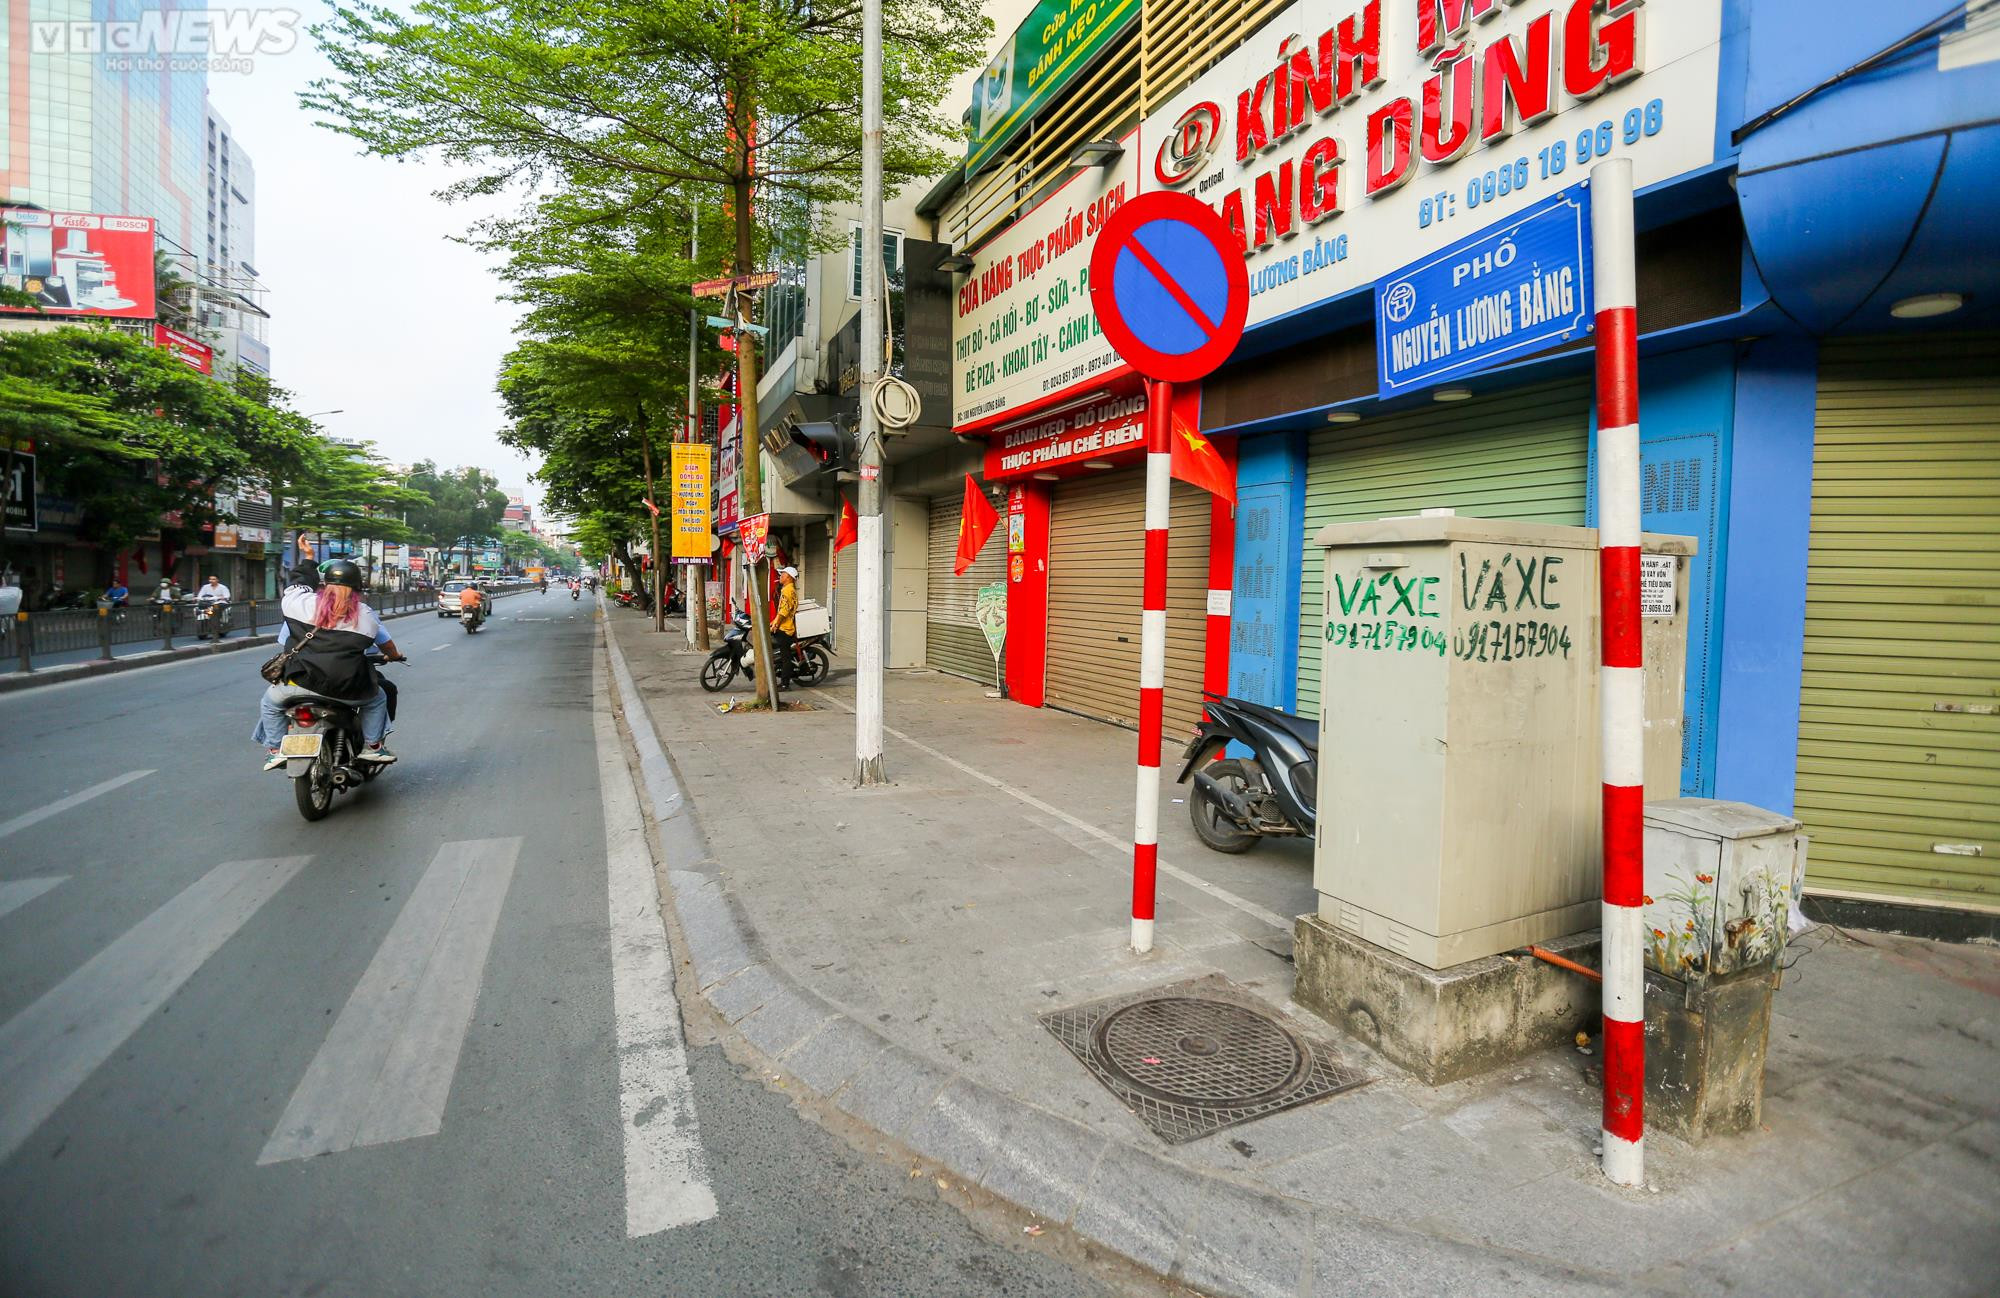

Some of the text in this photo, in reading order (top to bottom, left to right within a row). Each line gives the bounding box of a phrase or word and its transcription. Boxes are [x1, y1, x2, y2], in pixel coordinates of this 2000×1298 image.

[1028, 37, 1063, 88] BÁNH
[1066, 3, 1096, 47] KẸO
[1237, 0, 1384, 164] KÍNH
[1366, 0, 1646, 198] DŨNG
[1419, 98, 1663, 229] ĐT: 0986 18 96 98
[116, 220, 147, 229] BOSCH
[1017, 238, 1045, 283] THỰC
[1047, 206, 1083, 264] PHẨM
[1453, 227, 1520, 288] PHỐ
[1250, 234, 1348, 297] LƯƠNG BẰNG
[956, 335, 970, 363] THỊT
[972, 323, 983, 354] BÒ
[990, 314, 1001, 344] CÁ
[1002, 302, 1017, 338] HỒI
[1026, 294, 1040, 326] BƠ
[1048, 277, 1069, 314] SỮA
[977, 361, 995, 389] PIZA
[1003, 344, 1029, 378] KHOAI
[1031, 332, 1049, 365] TÂY
[1059, 312, 1089, 353] CÁNH
[1392, 261, 1574, 374] NGUYỄN LƯƠNG BẰNG
[1051, 374, 1061, 388] 0243
[1089, 357, 1101, 372] 0973
[1001, 419, 1144, 470] THỰC PHẨM CHẾ BIẾN
[1387, 576, 1440, 617] XE
[1515, 556, 1563, 610] XE
